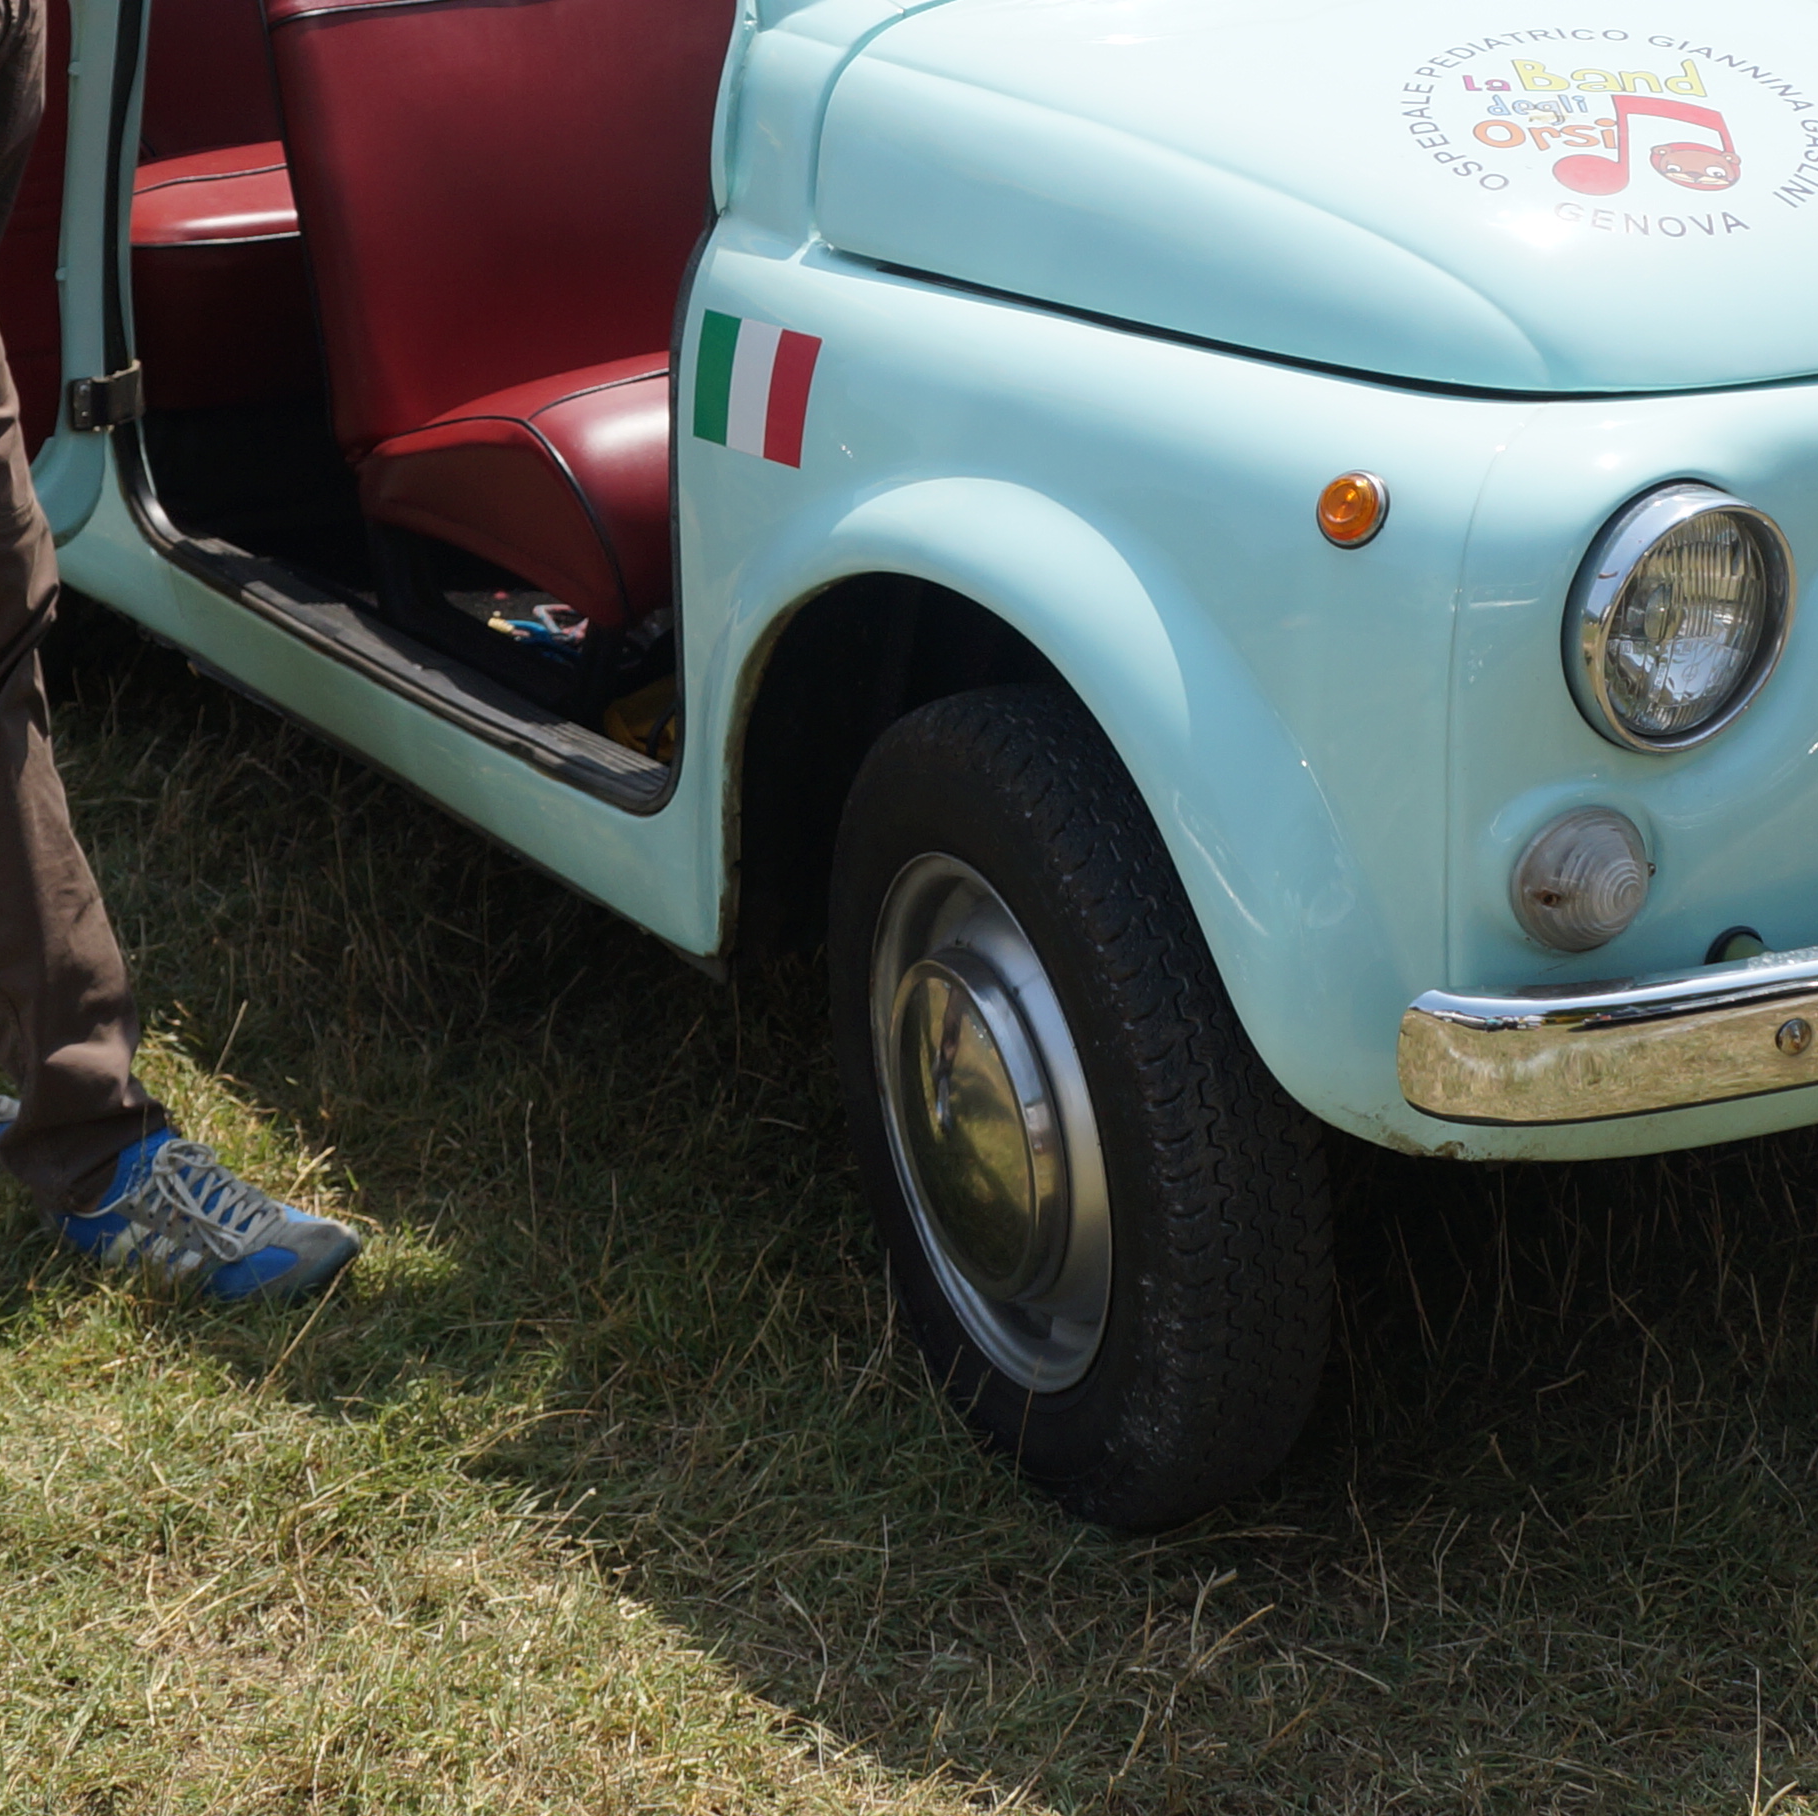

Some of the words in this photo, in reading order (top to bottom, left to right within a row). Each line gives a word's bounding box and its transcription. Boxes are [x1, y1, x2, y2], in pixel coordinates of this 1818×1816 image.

[1414, 27, 1629, 79] PEDIATRICO
[1461, 74, 1512, 92] La
[1510, 58, 1708, 98] Band
[1647, 35, 1815, 112] GIANNINA
[1486, 94, 1589, 127] degli
[1400, 82, 1510, 191] OSPEDALE
[1472, 117, 1618, 152] Orsi
[1554, 202, 1751, 238] GENOVA
